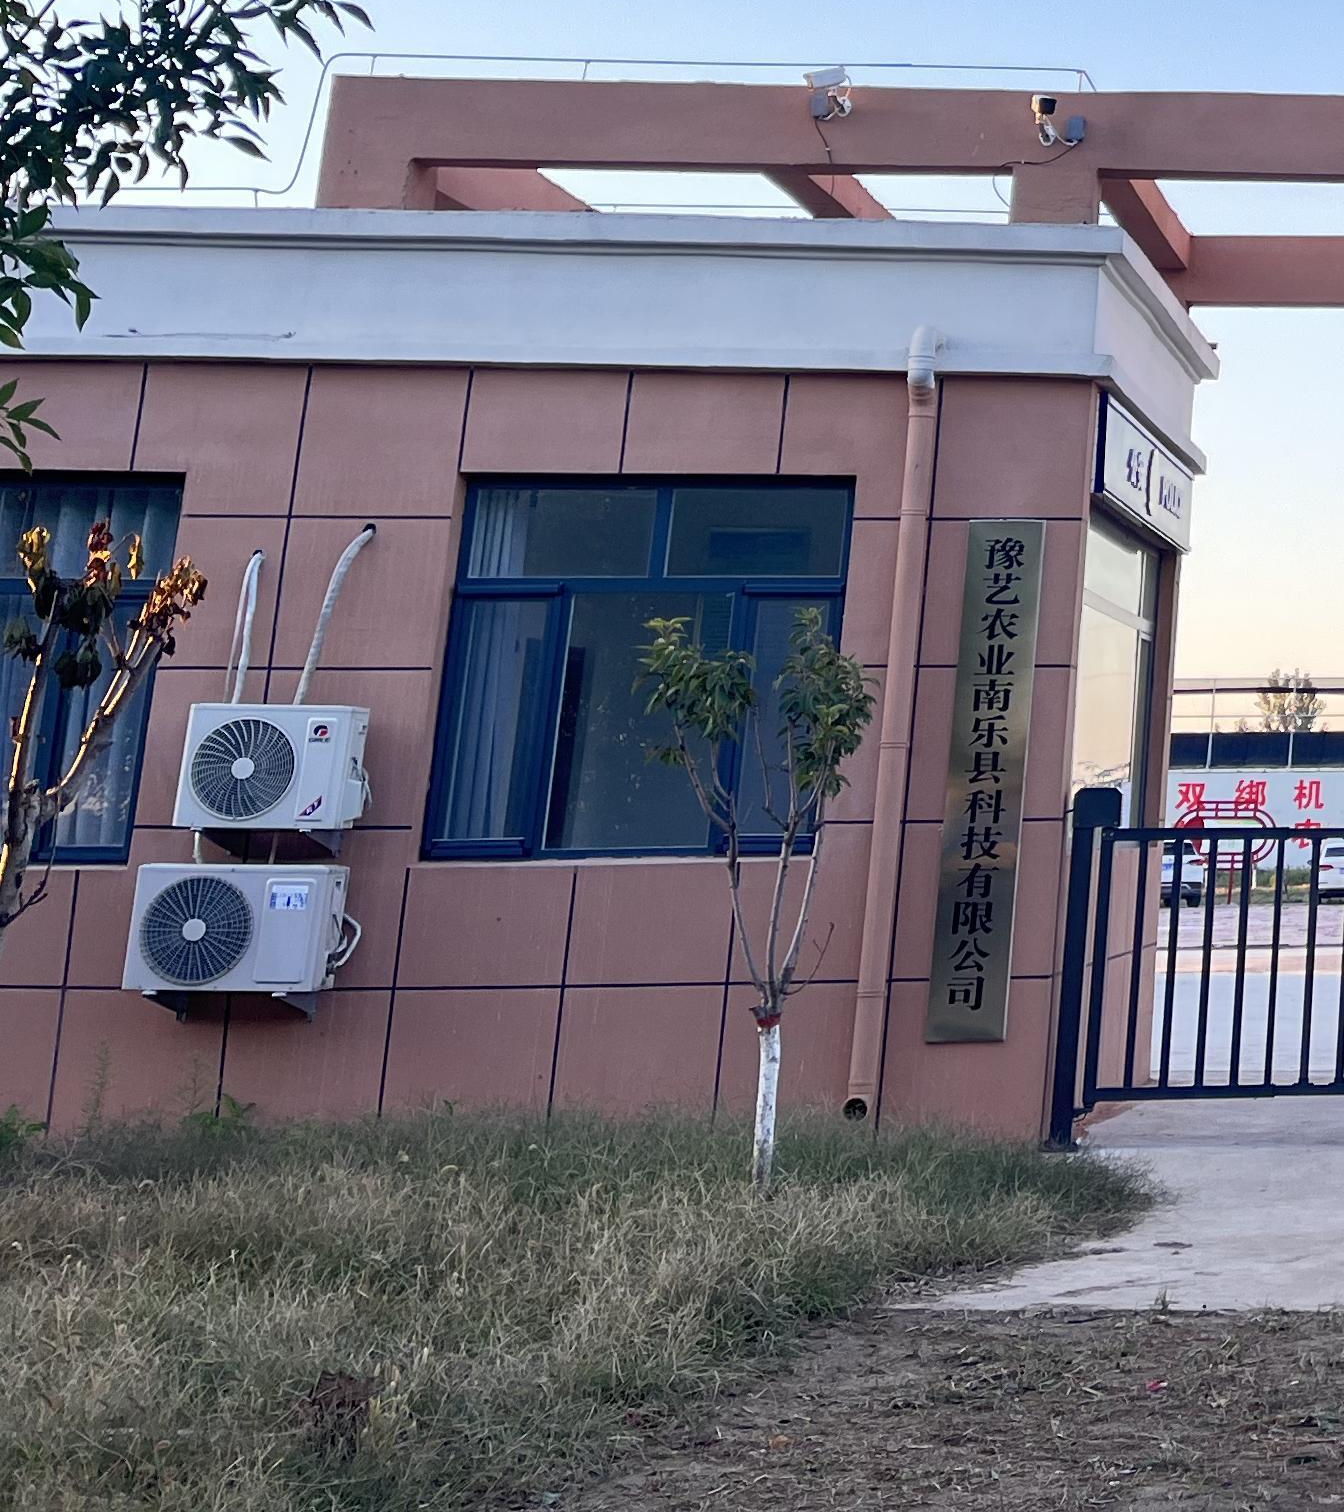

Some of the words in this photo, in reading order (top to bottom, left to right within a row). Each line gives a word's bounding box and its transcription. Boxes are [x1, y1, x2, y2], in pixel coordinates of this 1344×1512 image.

[946, 537, 1025, 1012] 豫艺农业南乐县科技有限公司
